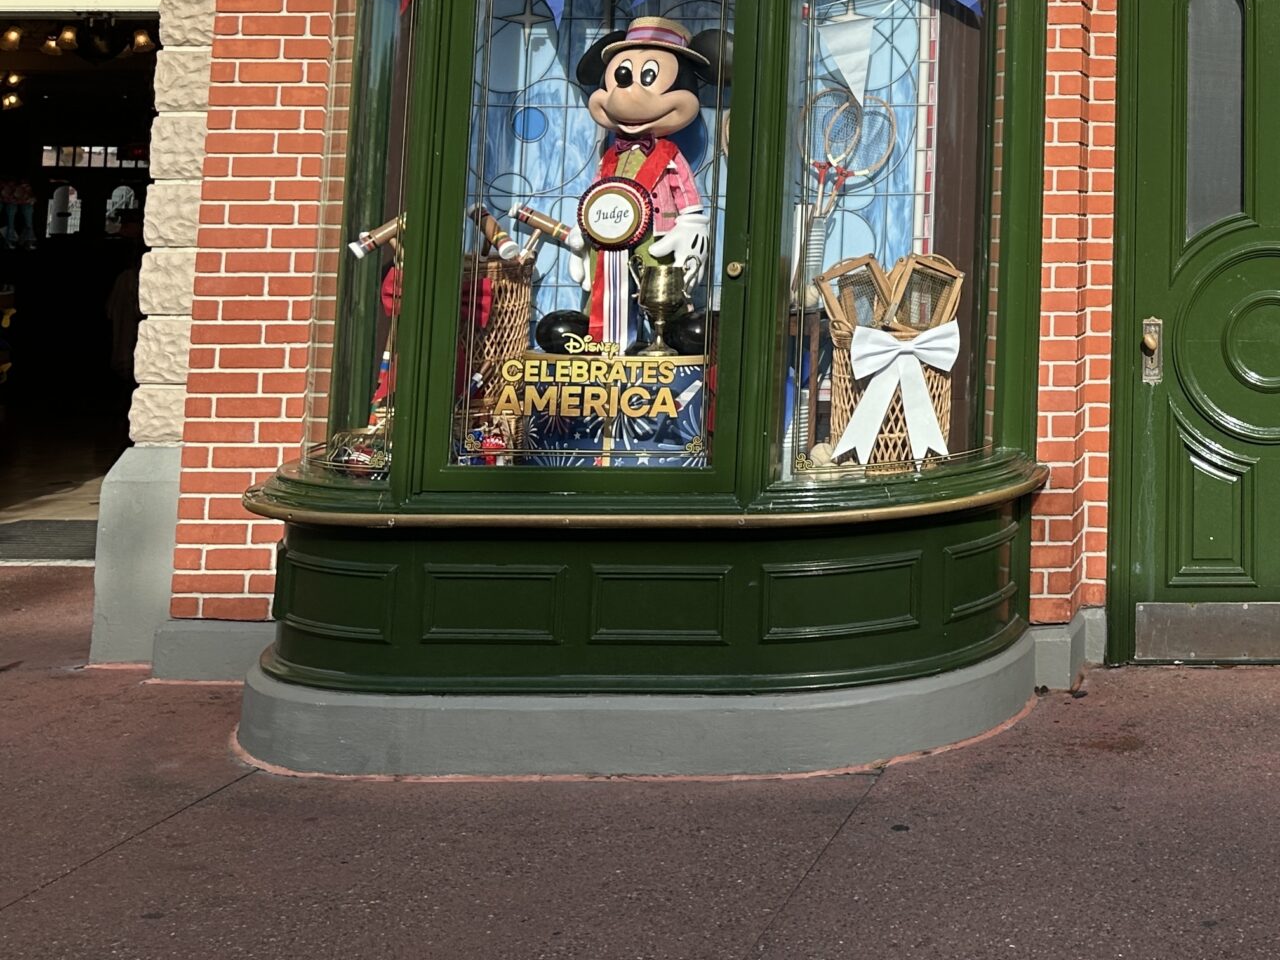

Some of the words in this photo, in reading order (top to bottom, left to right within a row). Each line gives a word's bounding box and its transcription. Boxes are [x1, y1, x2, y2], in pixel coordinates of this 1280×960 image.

[594, 205, 629, 224] Judge
[501, 360, 676, 383] CELEBRATES
[493, 385, 678, 417] AMERICA
